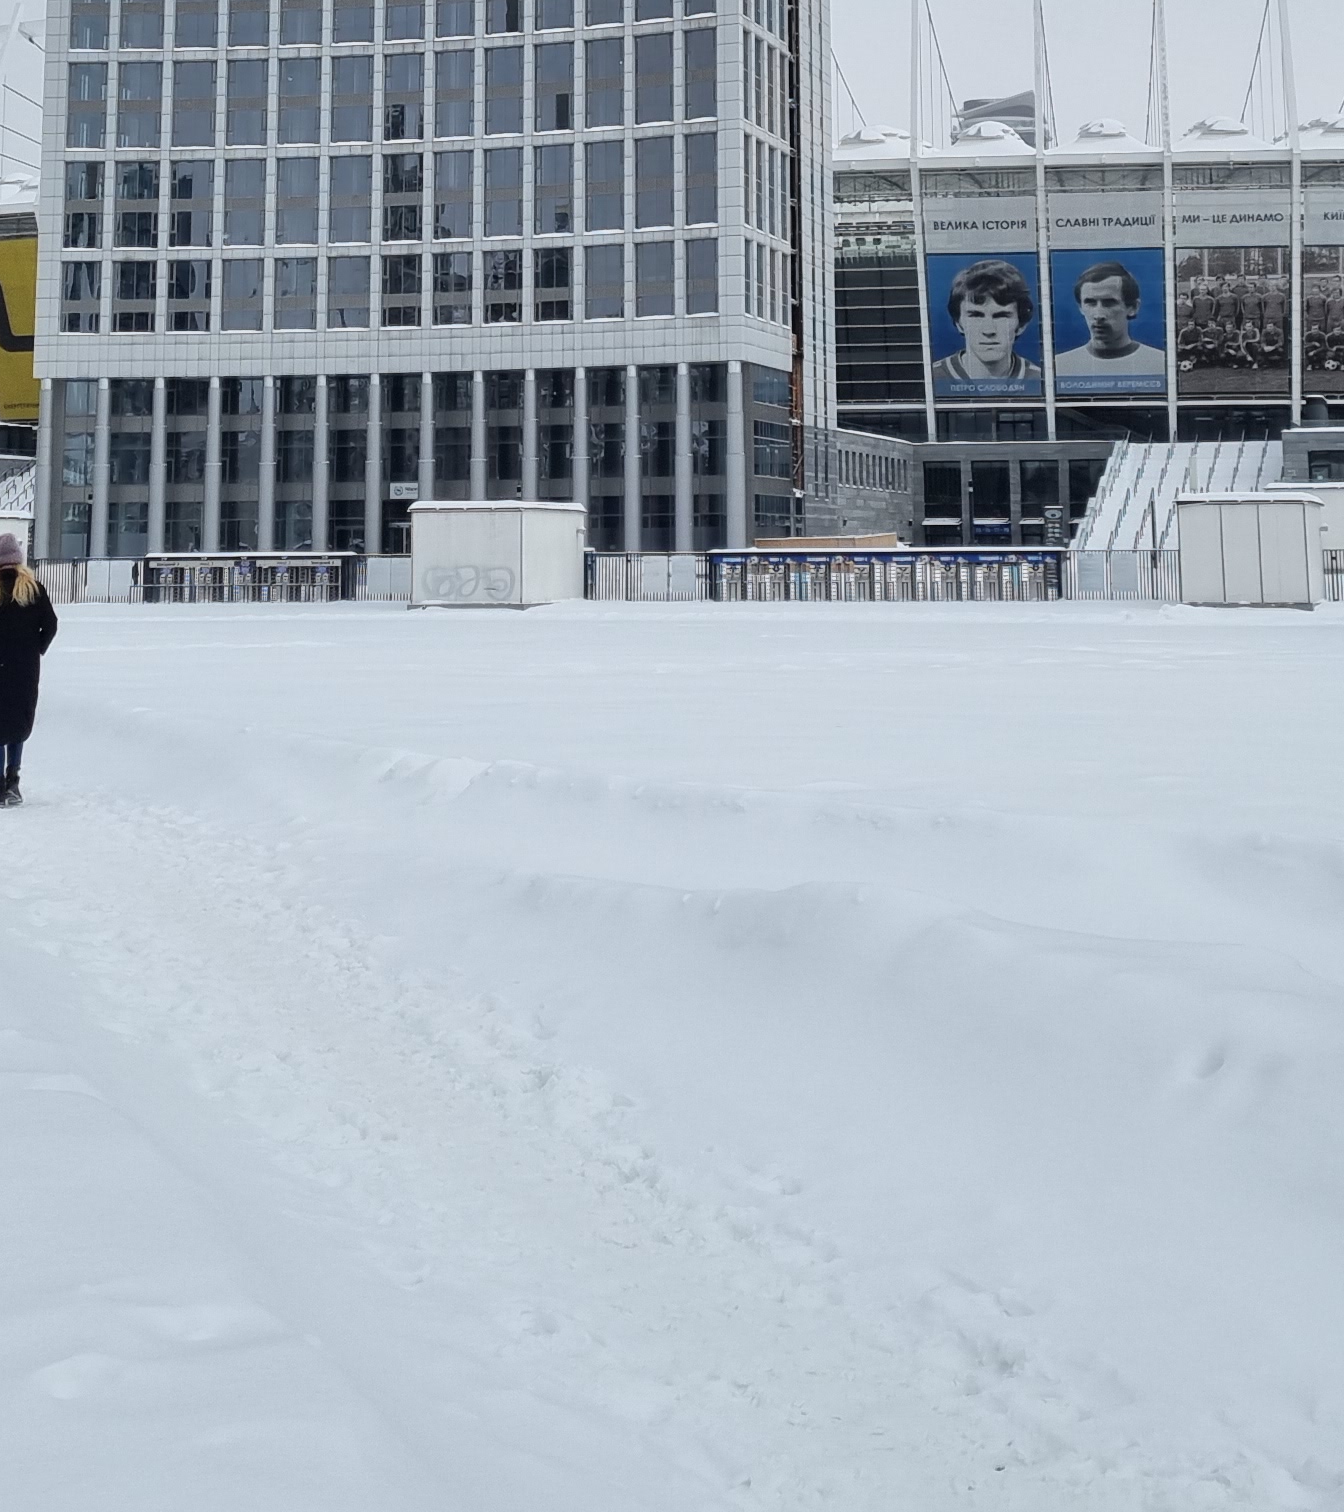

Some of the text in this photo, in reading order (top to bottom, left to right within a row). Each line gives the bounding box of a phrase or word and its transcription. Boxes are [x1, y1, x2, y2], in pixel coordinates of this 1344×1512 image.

[1055, 214, 1156, 228] СЛАВНІ ТРАДИЦІЇ
[1181, 214, 1201, 223] МИ
[1212, 214, 1227, 224] ЦЕ
[1229, 213, 1284, 224] ДИНАМО
[933, 219, 1028, 231] ВЕЛИКА ІСТОРІЯ
[950, 384, 976, 392] ПЕТРО
